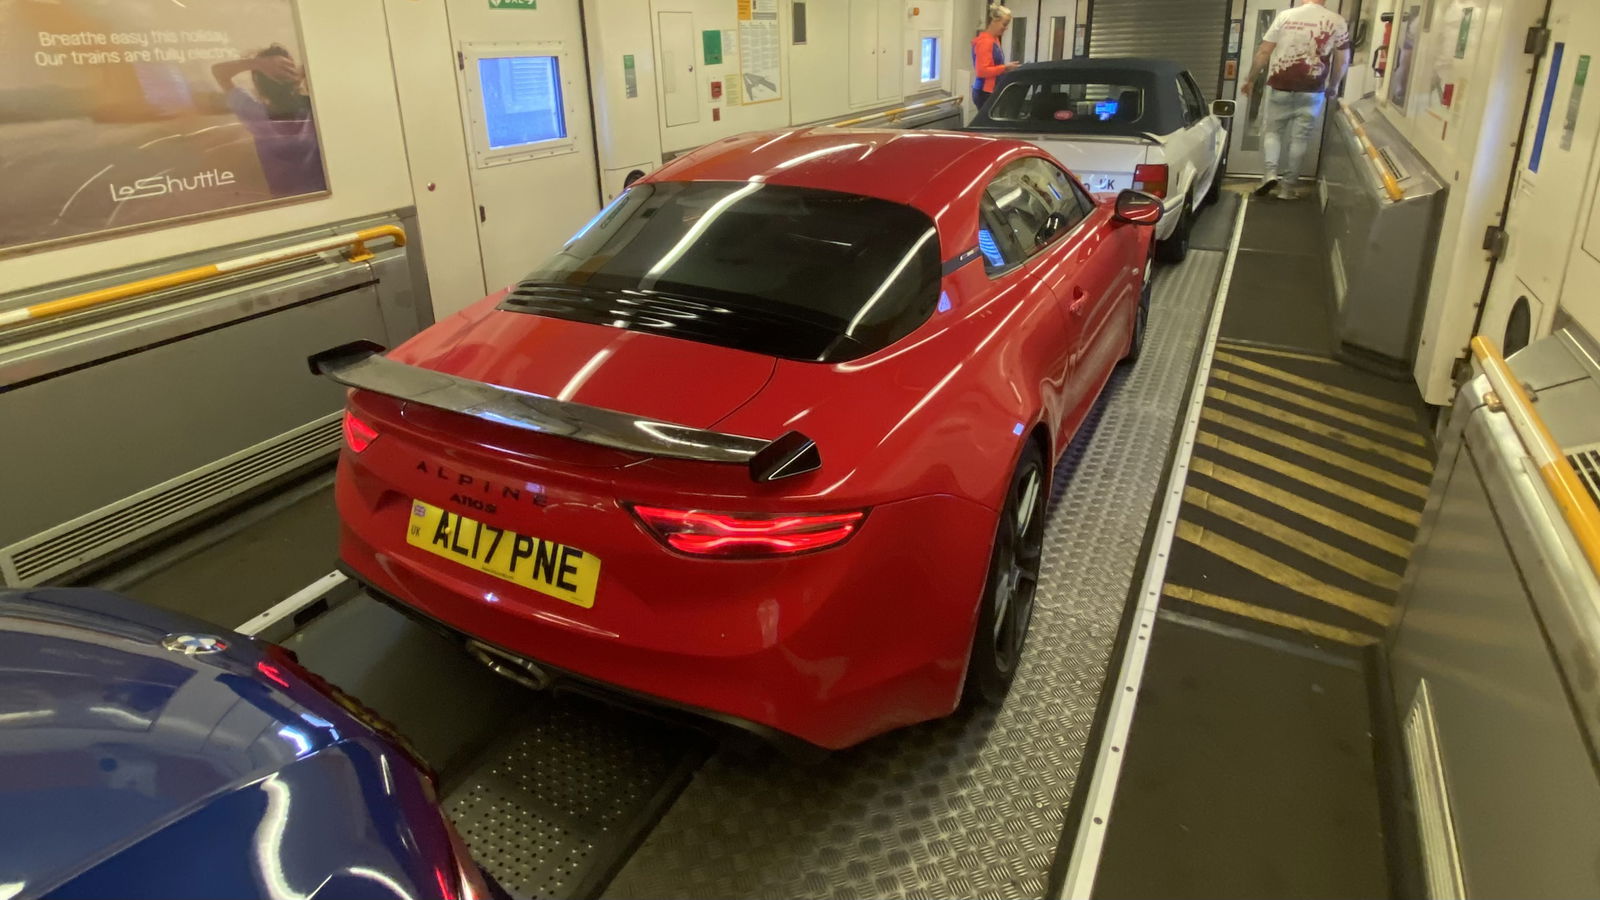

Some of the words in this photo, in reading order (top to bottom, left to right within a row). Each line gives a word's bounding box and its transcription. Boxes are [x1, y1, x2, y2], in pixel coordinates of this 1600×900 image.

[38, 31, 107, 47] Breathe
[110, 32, 148, 47] easy
[151, 29, 178, 43] this
[34, 51, 67, 67] Our
[71, 50, 121, 65] trains
[124, 49, 151, 63] are
[153, 47, 185, 64] fully
[110, 168, 236, 202] LeShuttle
[416, 460, 549, 508] ALPINE
[410, 524, 421, 538] UK
[432, 508, 505, 564] AL17
[509, 531, 584, 593] PNE
